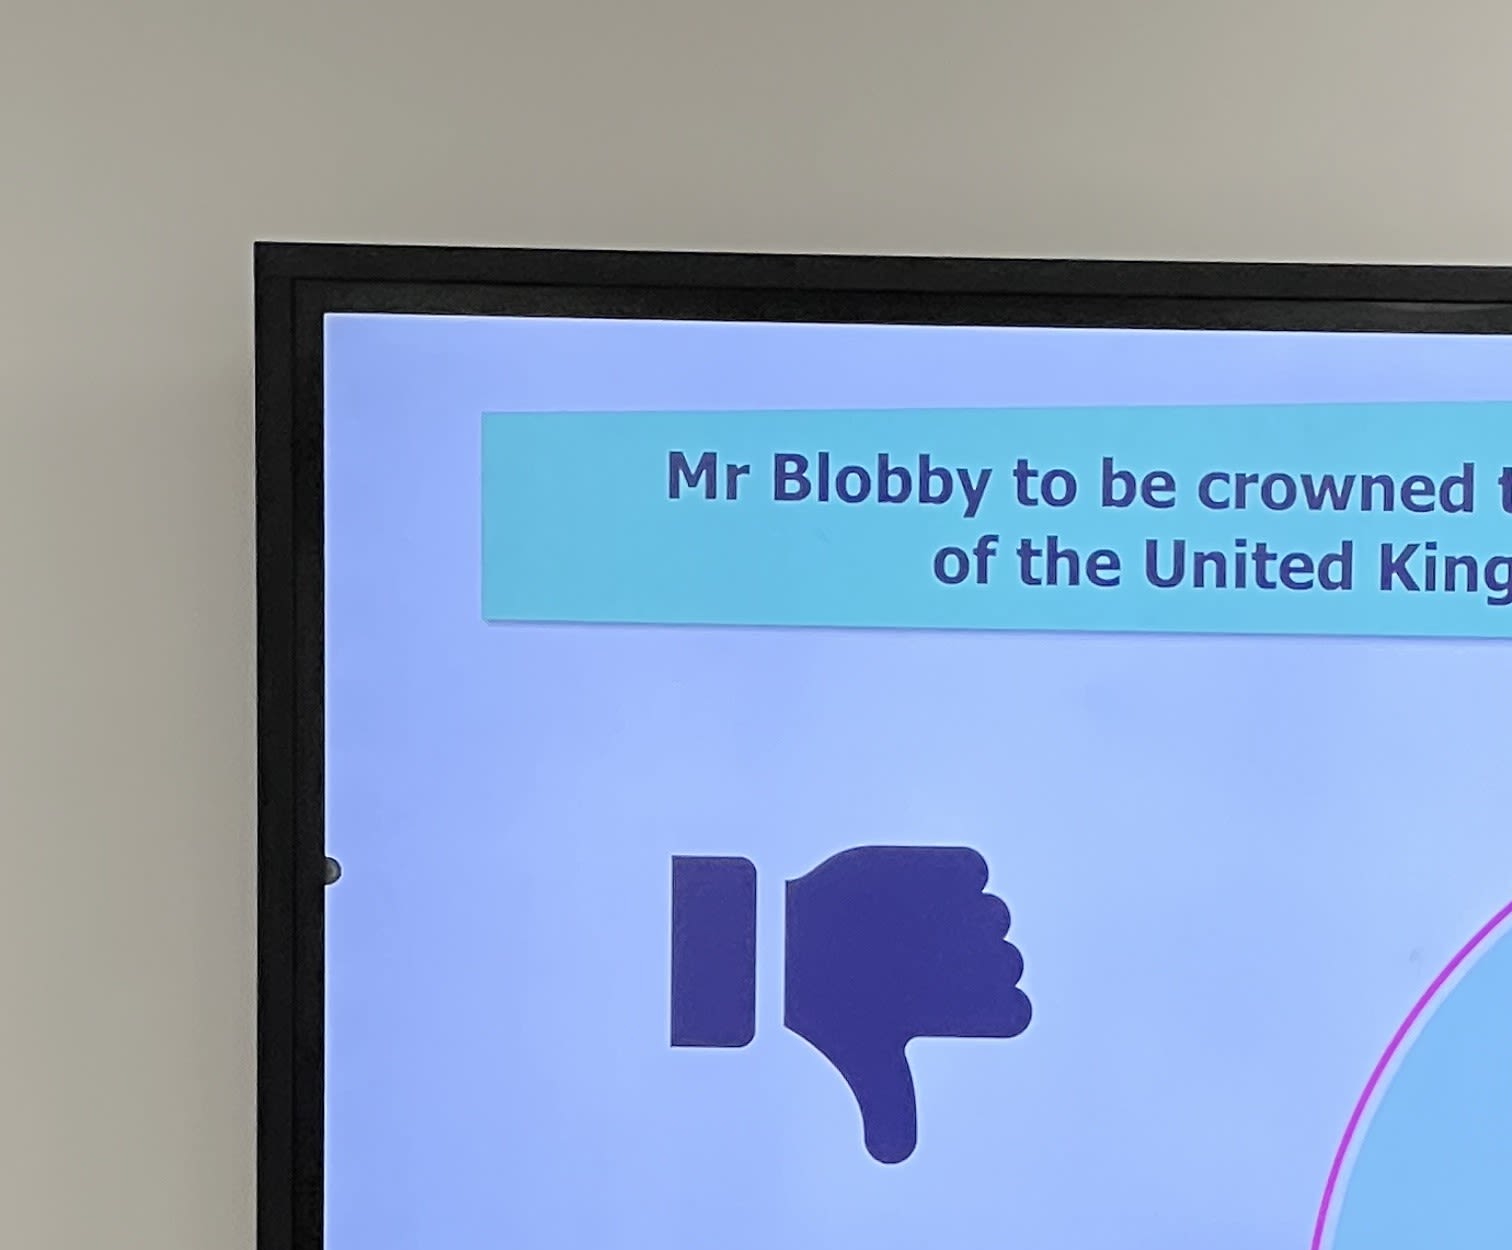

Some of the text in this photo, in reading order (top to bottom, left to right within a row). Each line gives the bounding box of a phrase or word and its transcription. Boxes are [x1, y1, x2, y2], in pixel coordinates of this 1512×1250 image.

[667, 450, 752, 502] Mr
[773, 452, 994, 519] Blobby
[1012, 458, 1078, 508] to
[1101, 456, 1177, 510] be
[1198, 461, 1476, 515] crowned
[933, 534, 1000, 587] of
[1015, 534, 1122, 589] the
[1145, 538, 1354, 592] United
